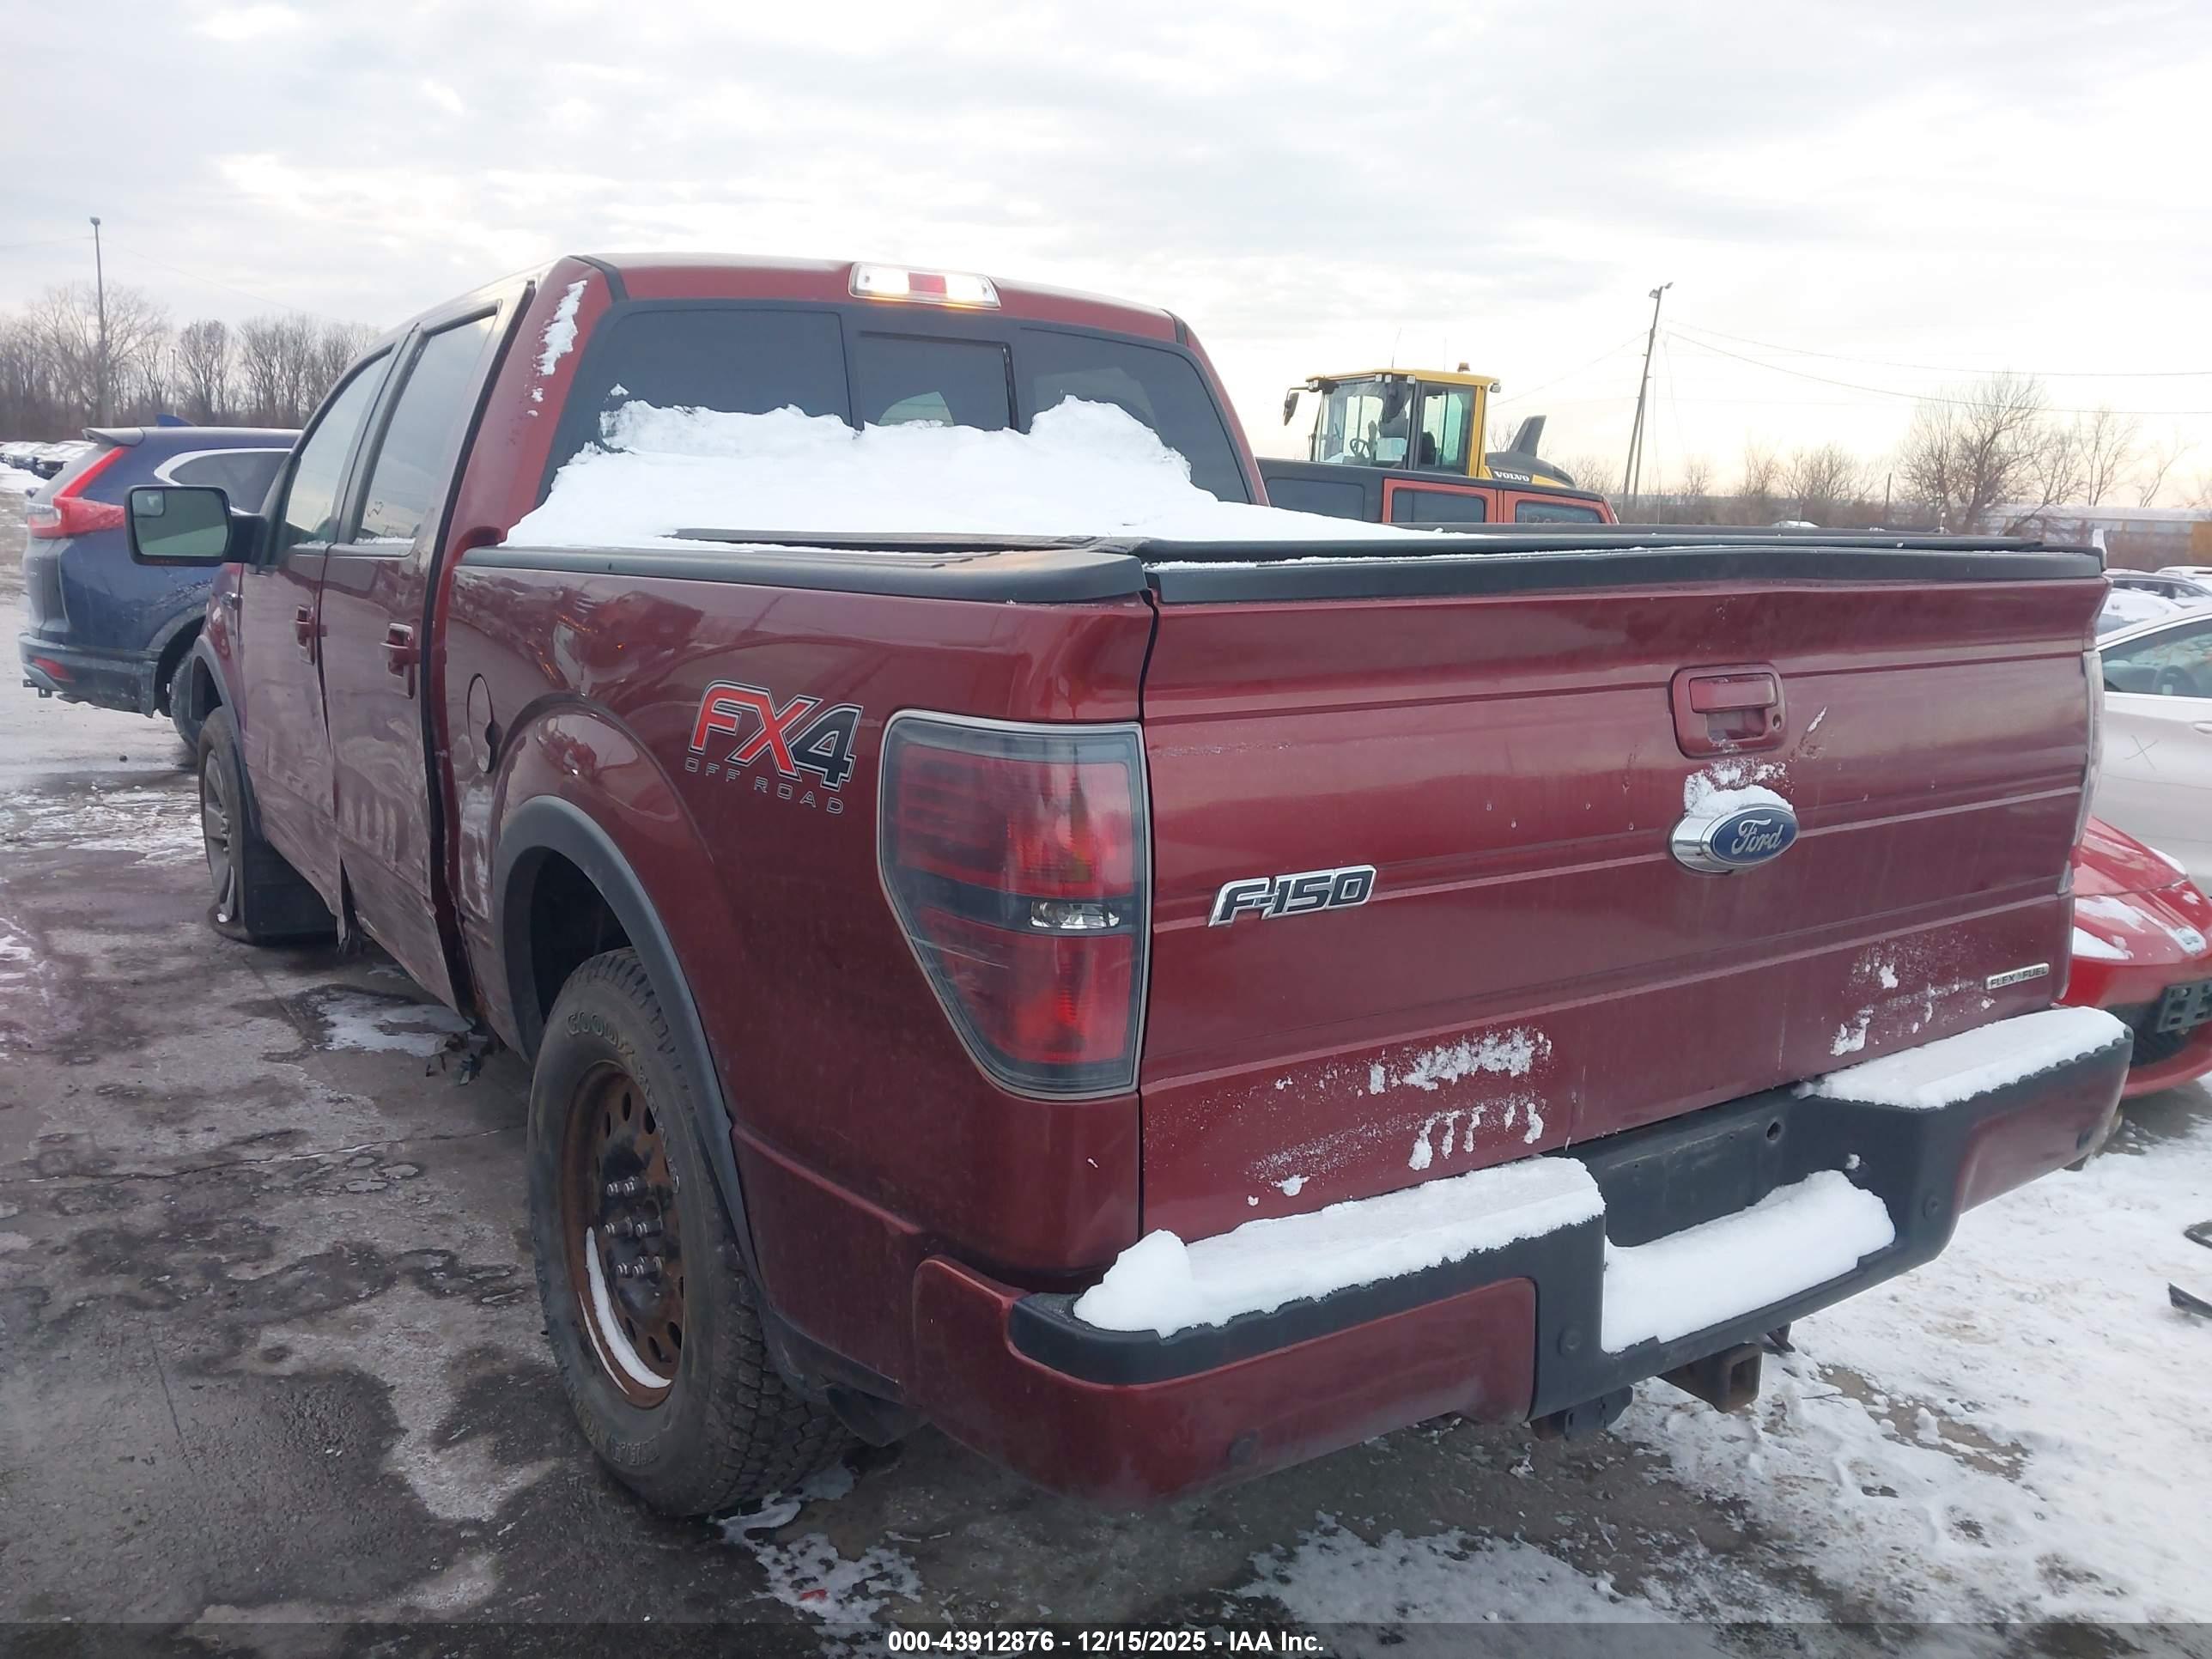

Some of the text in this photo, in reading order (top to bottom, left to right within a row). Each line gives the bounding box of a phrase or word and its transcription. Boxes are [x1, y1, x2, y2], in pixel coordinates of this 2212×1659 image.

[1494, 470, 1530, 482] VOLVO
[688, 680, 863, 792] FX4
[685, 757, 844, 814] OFF ROAD
[1731, 818, 1784, 855] Ford
[1208, 864, 1377, 927] F-150
[1990, 966, 2047, 987] FLEX FUEL
